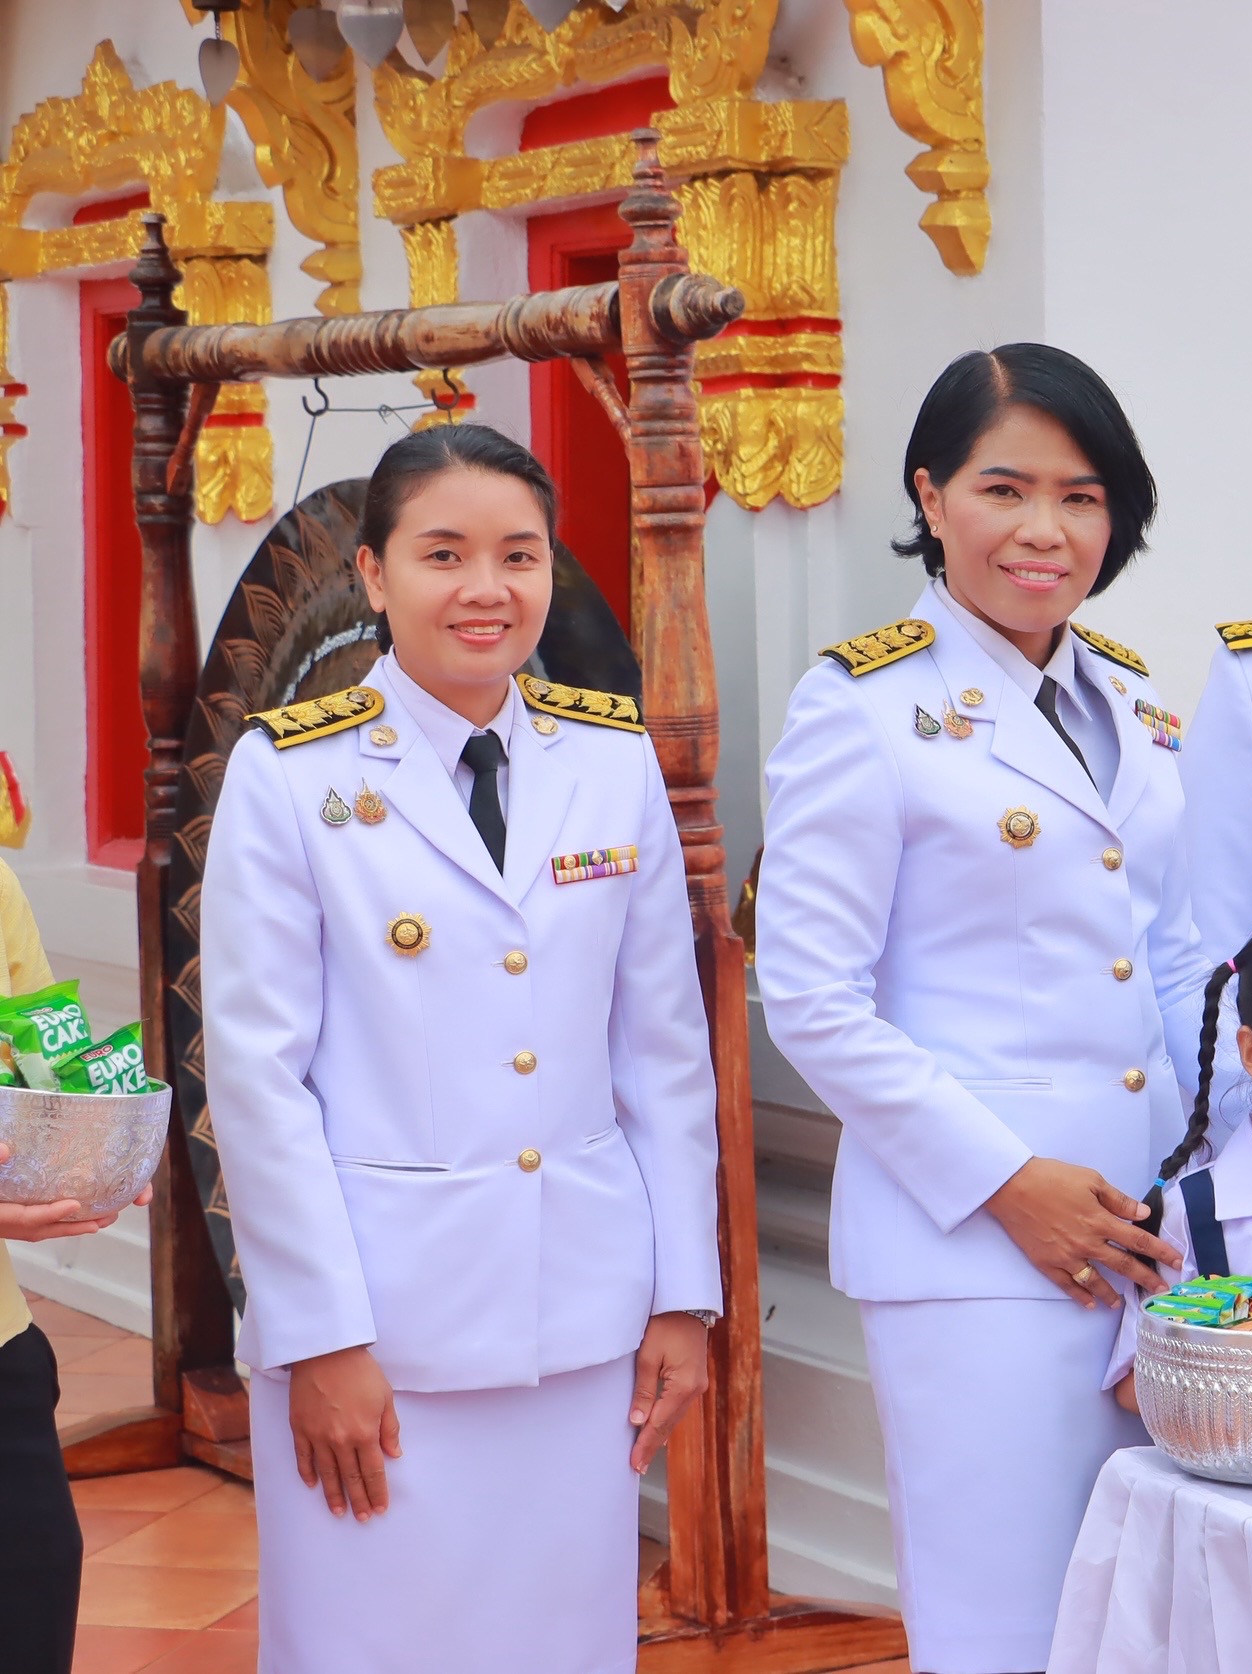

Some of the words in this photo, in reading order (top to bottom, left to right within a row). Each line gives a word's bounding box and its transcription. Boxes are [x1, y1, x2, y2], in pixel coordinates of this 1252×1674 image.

[30, 1004, 82, 1031] EURO
[81, 1045, 113, 1061] EURO
[88, 1043, 142, 1087] EURO
